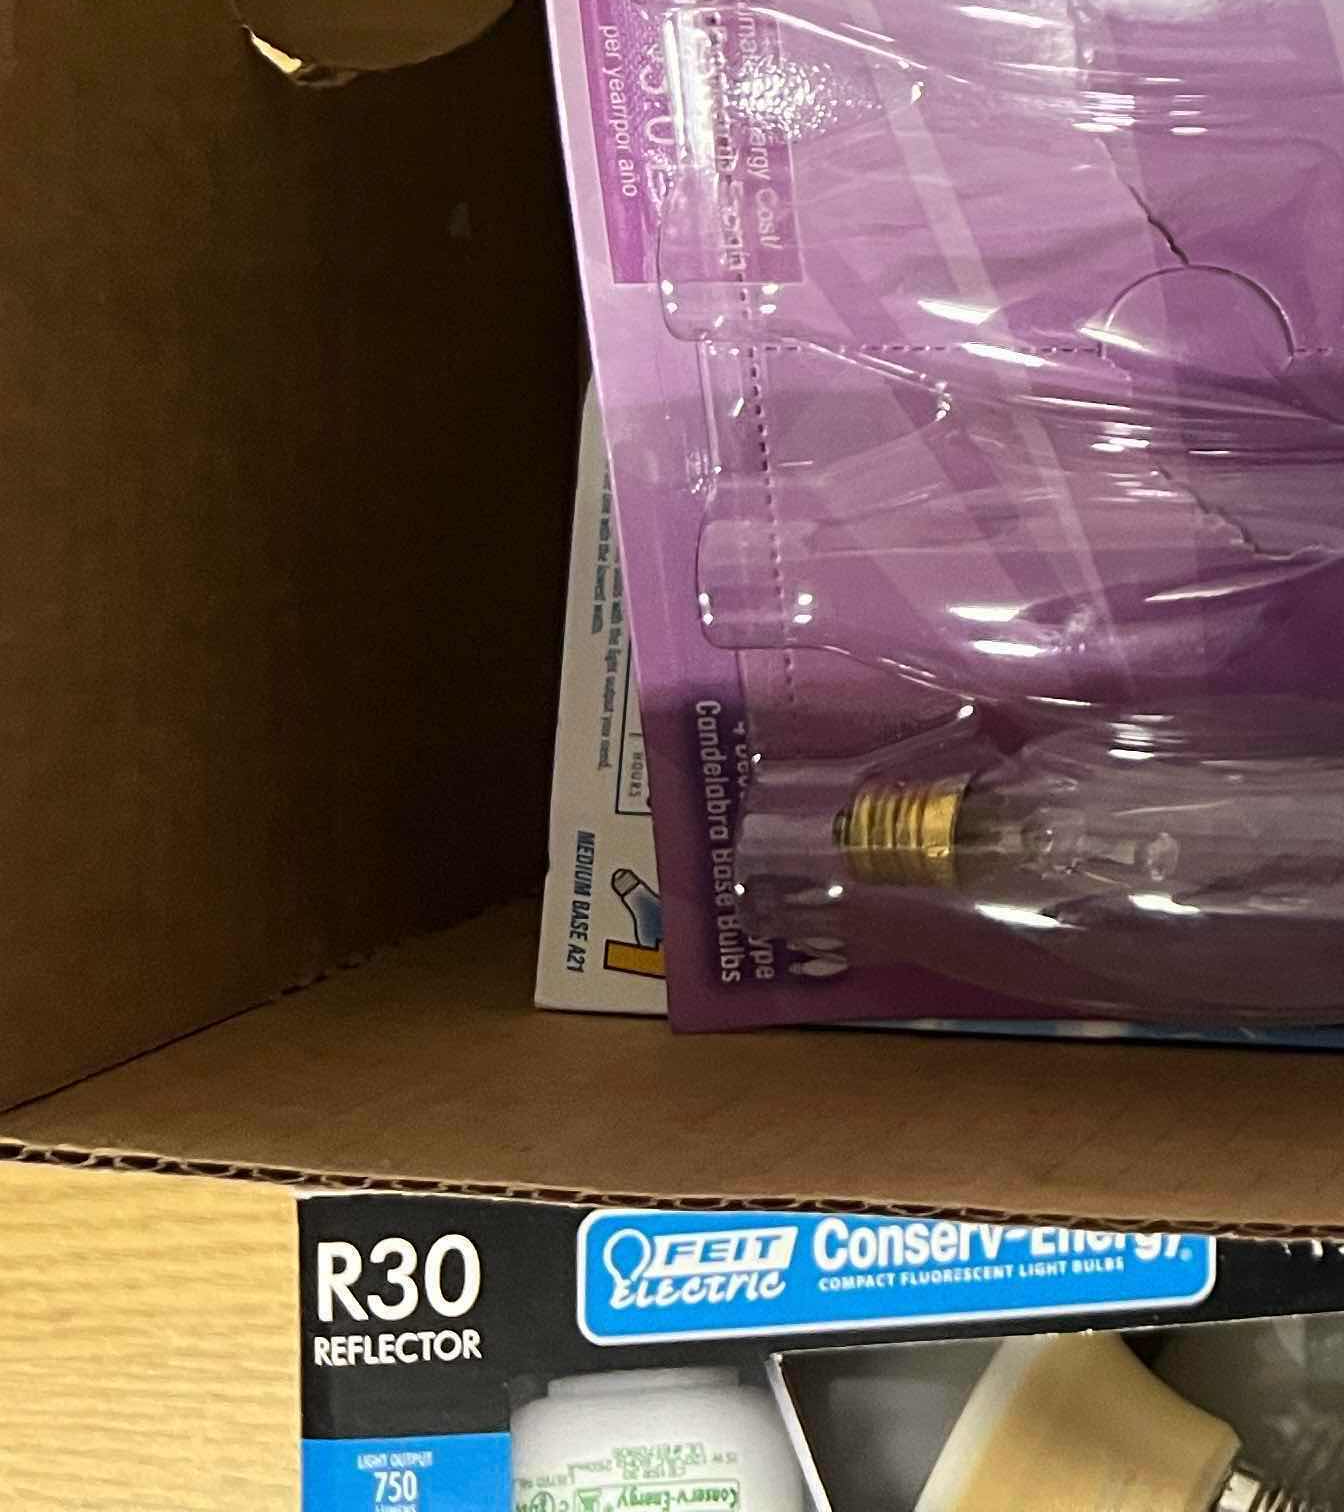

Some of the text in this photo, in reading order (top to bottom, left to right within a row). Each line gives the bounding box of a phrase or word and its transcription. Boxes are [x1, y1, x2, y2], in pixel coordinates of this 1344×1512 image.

[598, 24, 619, 59] per
[628, 751, 643, 797] HOURS
[695, 699, 734, 840] Candelabra
[566, 830, 596, 972] MEDIUM BASE A21
[714, 914, 747, 983] Bulbs
[747, 934, 775, 980] ype
[664, 1234, 782, 1265] FEIT
[316, 1232, 478, 1323] R30
[819, 1257, 1125, 1293] COMPACT FLUORESCENT LIGHT BULBS
[314, 1333, 482, 1367] REFLECTOR
[373, 1470, 416, 1503] 750
